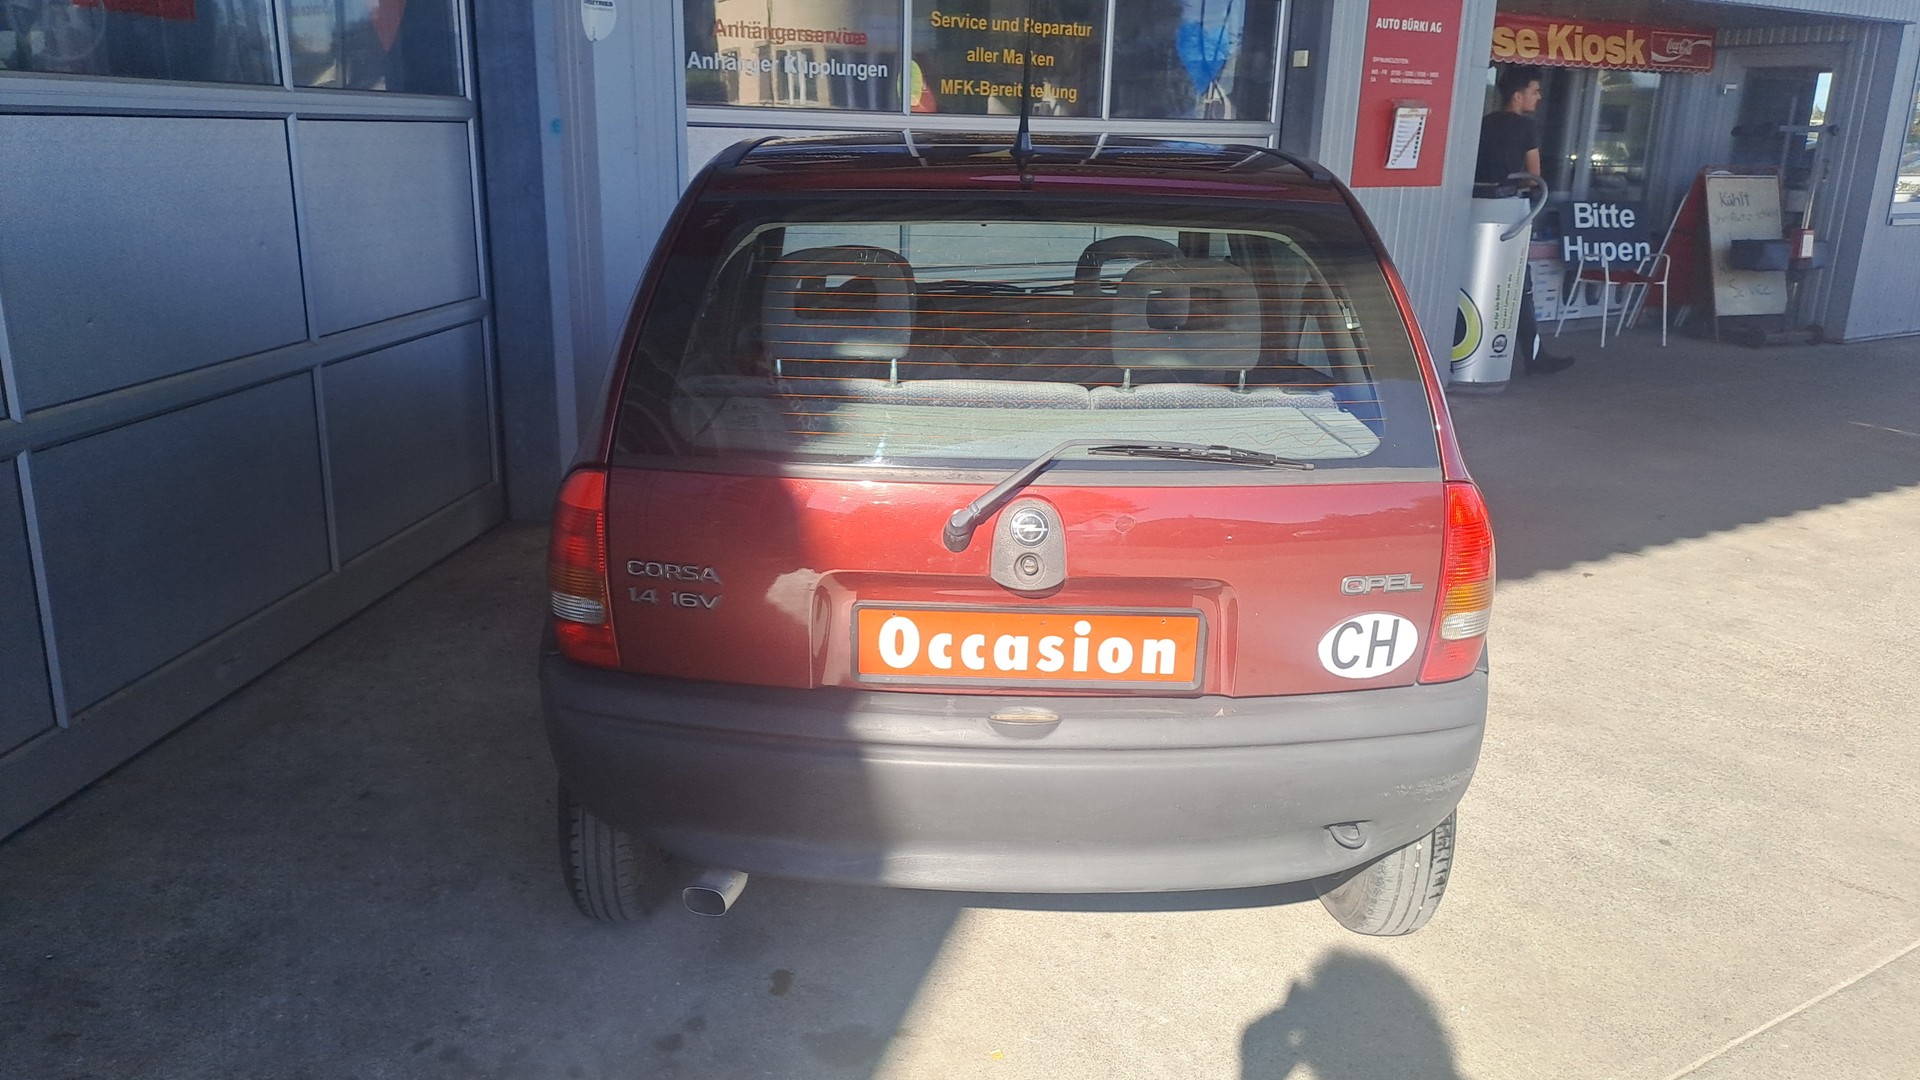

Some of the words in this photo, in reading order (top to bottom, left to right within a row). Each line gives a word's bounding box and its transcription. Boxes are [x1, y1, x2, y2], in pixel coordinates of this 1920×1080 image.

[931, 11, 988, 31] Service
[991, 18, 1020, 32] und
[1024, 18, 1093, 38] Reparatur
[1376, 17, 1400, 30] AUTO
[1401, 17, 1429, 32] BÜRKI
[1429, 22, 1443, 33] AG
[1548, 23, 1646, 65] Kiosk
[967, 47, 999, 63] aller
[1003, 49, 1055, 67] Maken
[940, 79, 1078, 103] MFK-Bereitteung
[1573, 202, 1636, 229] Bitte
[1563, 235, 1651, 268] Hupen
[626, 560, 723, 584] CORSA
[1340, 572, 1425, 596] OPEL
[671, 590, 722, 610] 16V
[878, 615, 1177, 675] Occasion
[1331, 618, 1400, 670] CH
